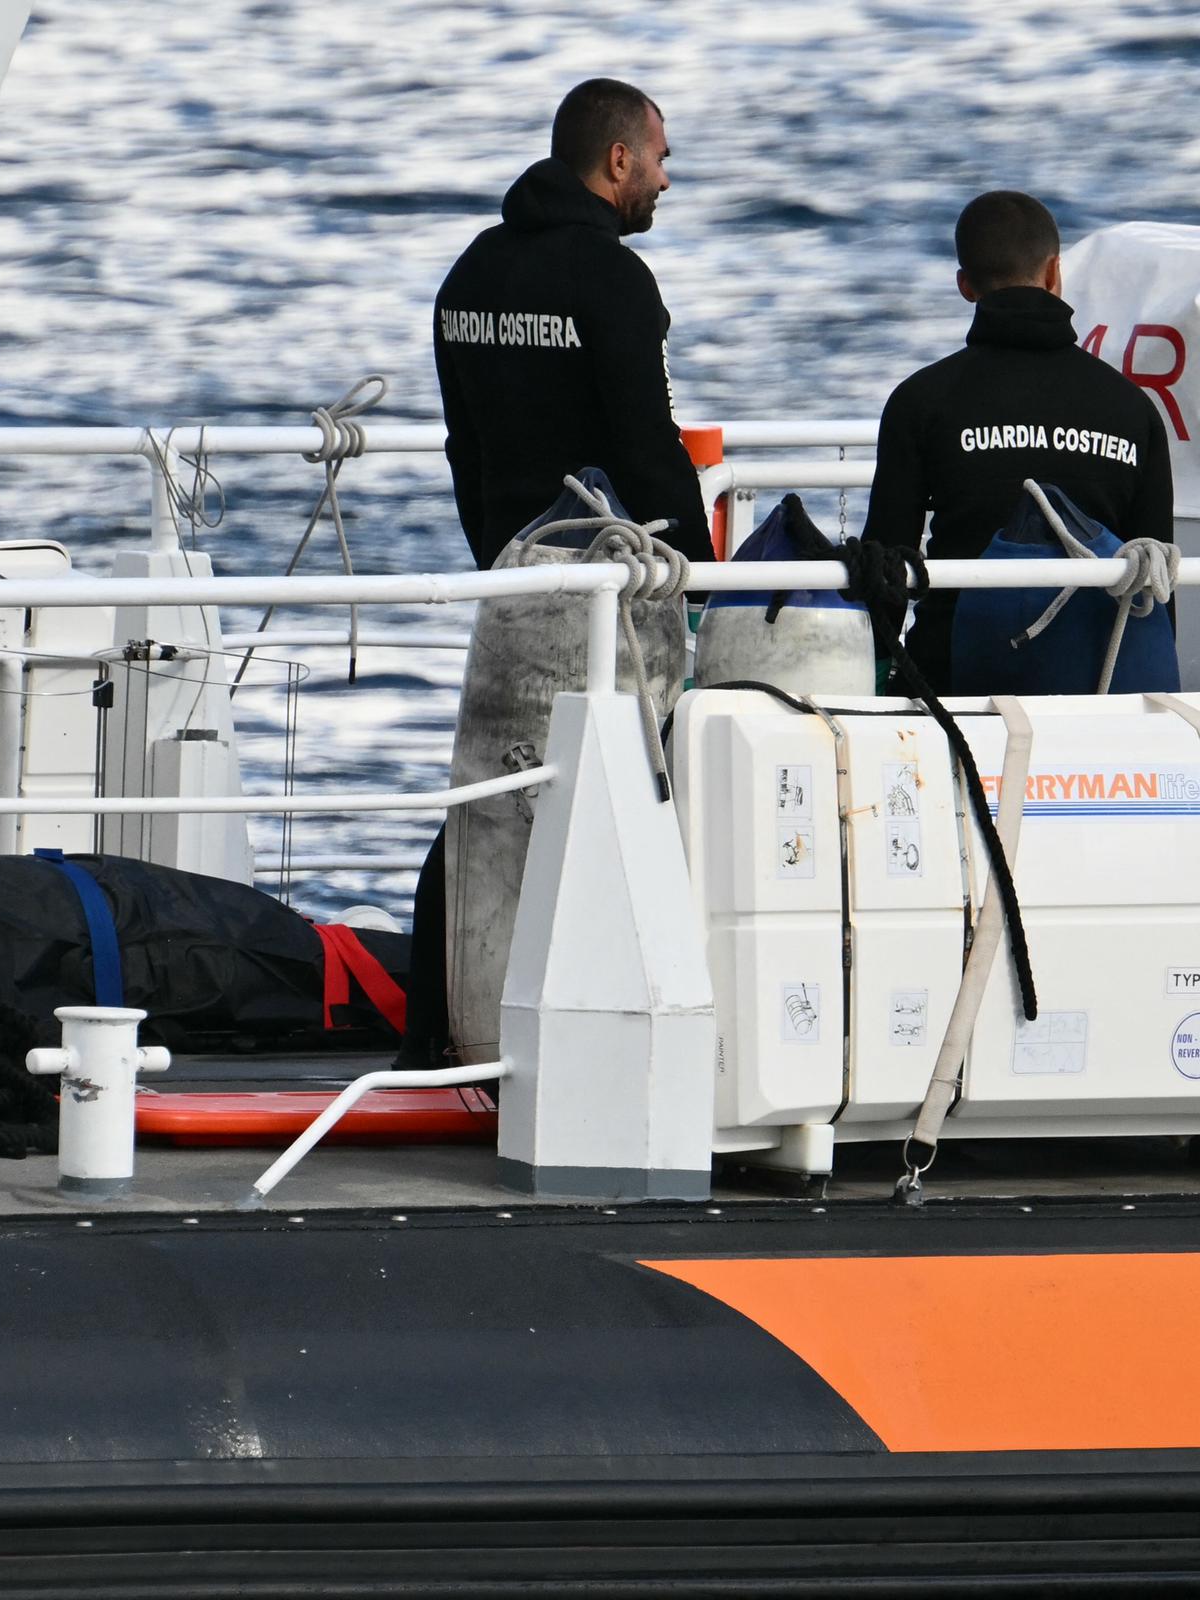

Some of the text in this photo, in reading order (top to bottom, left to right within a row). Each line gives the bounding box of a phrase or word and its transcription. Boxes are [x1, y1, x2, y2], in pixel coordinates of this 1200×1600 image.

[441, 308, 582, 348] GUARDIA COSTIERA
[961, 424, 1137, 466] GUARDIA COSTIERA
[1177, 1034, 1192, 1044] NON
